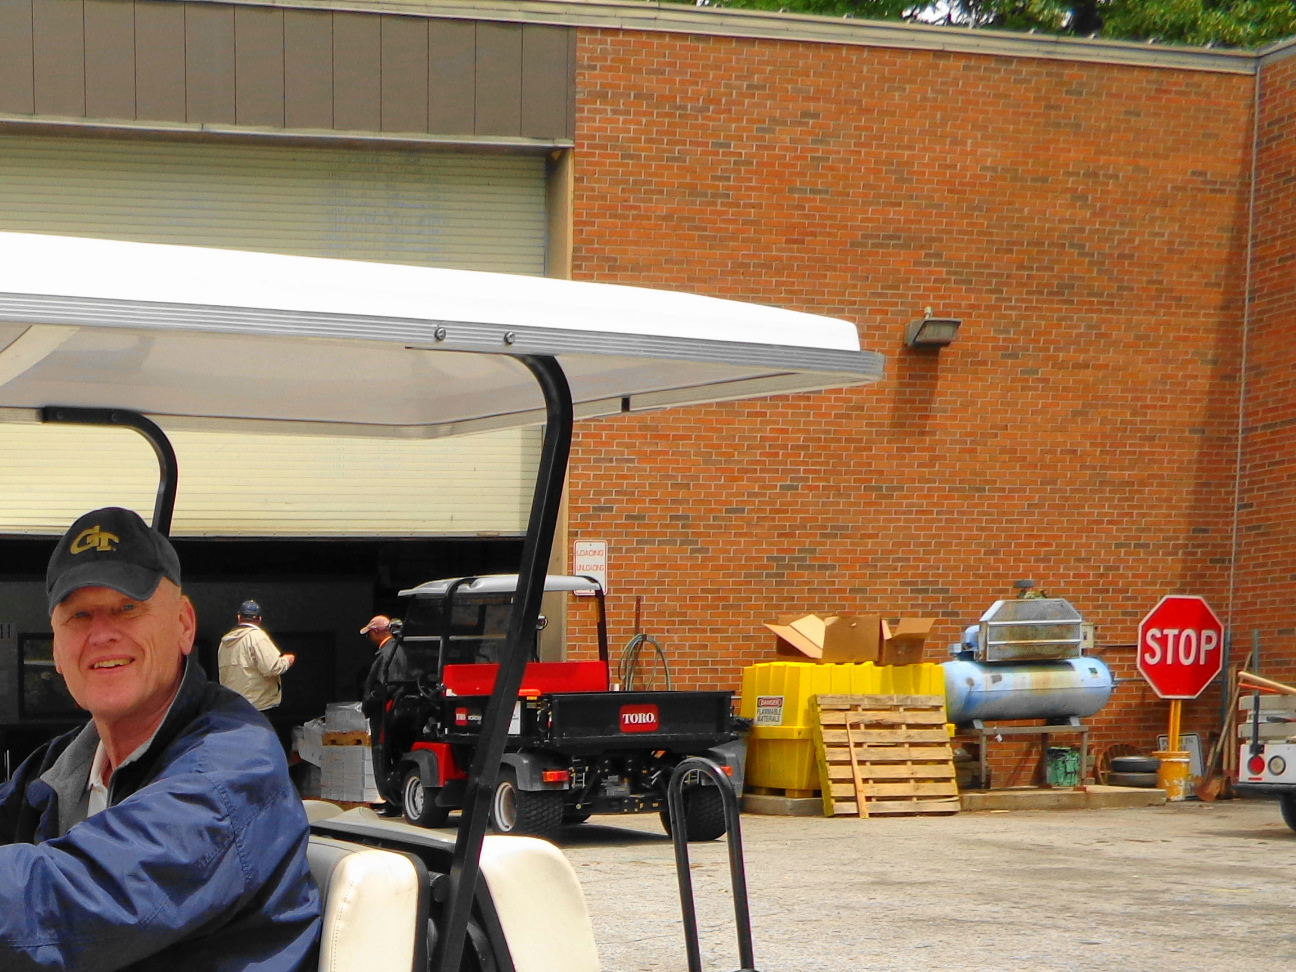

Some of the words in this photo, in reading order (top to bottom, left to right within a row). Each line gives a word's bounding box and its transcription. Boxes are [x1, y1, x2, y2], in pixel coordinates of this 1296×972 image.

[576, 549, 604, 557] LOADING
[1144, 628, 1218, 666] STOP
[622, 712, 655, 725] TORO
